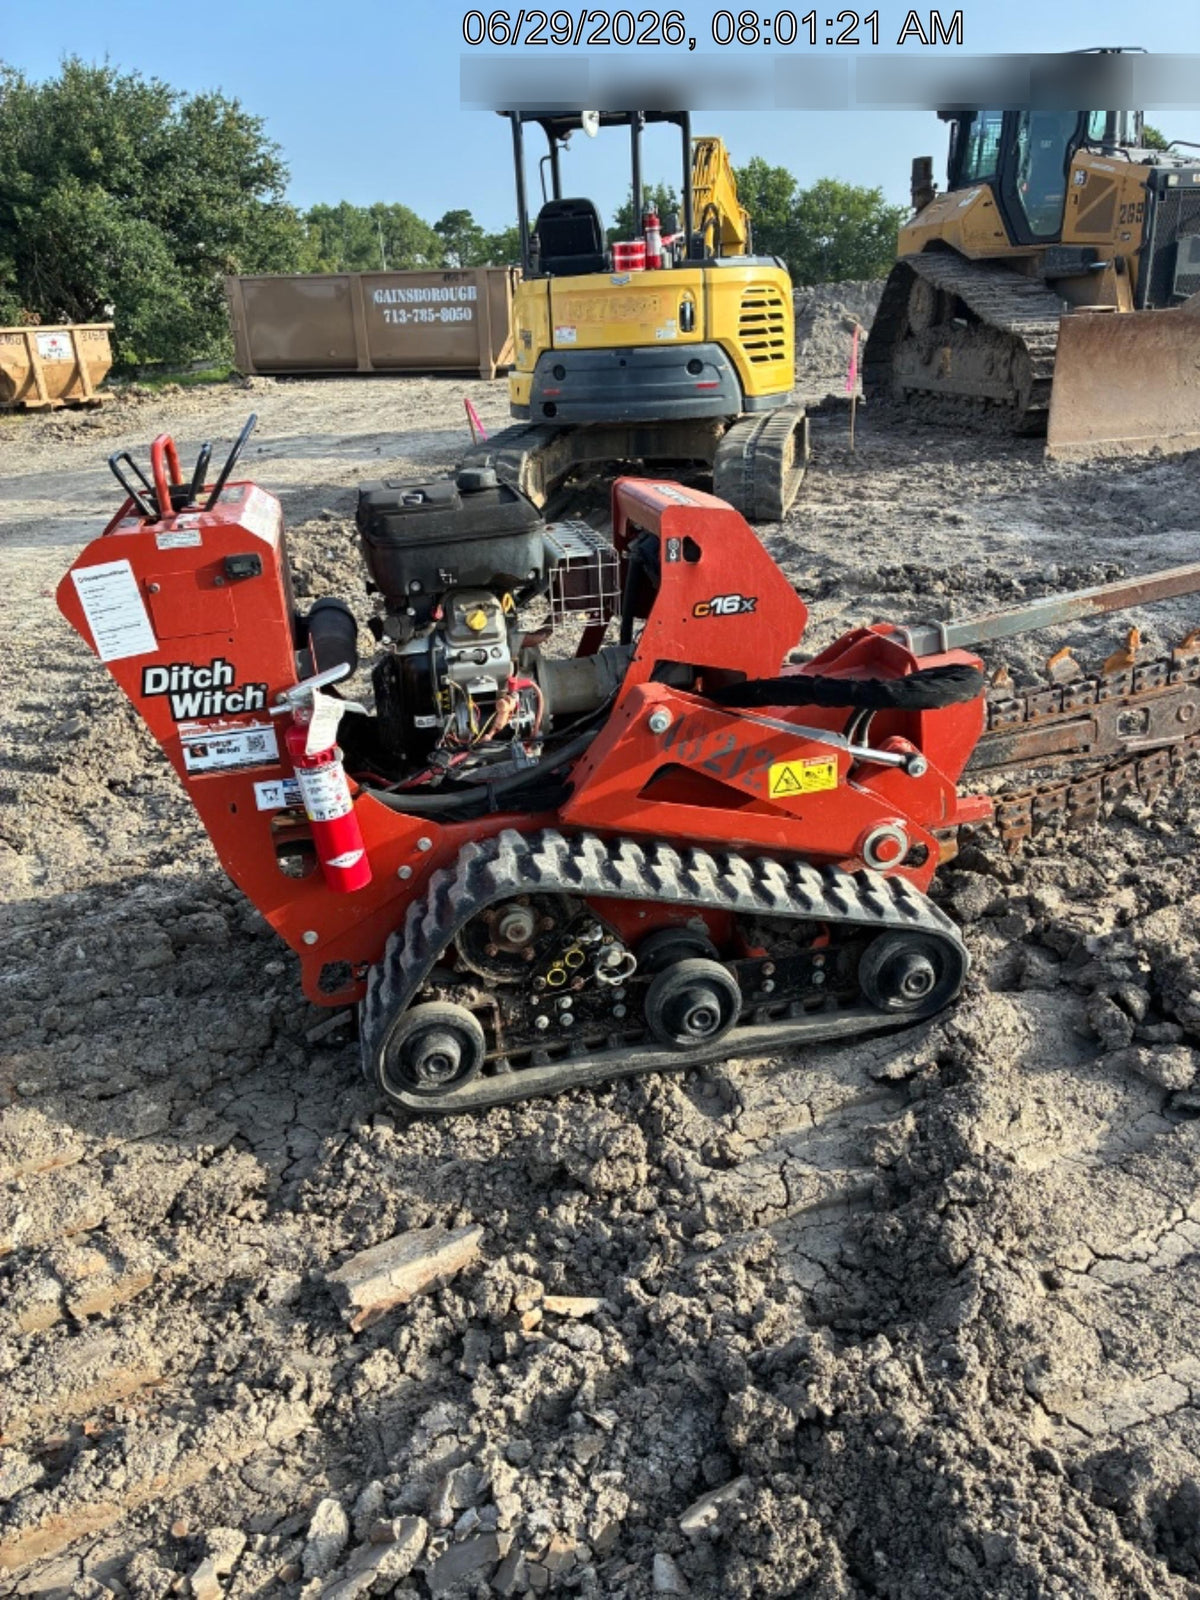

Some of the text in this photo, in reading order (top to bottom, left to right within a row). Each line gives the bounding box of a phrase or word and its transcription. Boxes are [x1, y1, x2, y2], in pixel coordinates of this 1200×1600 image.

[373, 285, 478, 304] GAINSBOROUGH
[383, 306, 473, 324] 713-785-8050
[144, 659, 233, 696] Ditch
